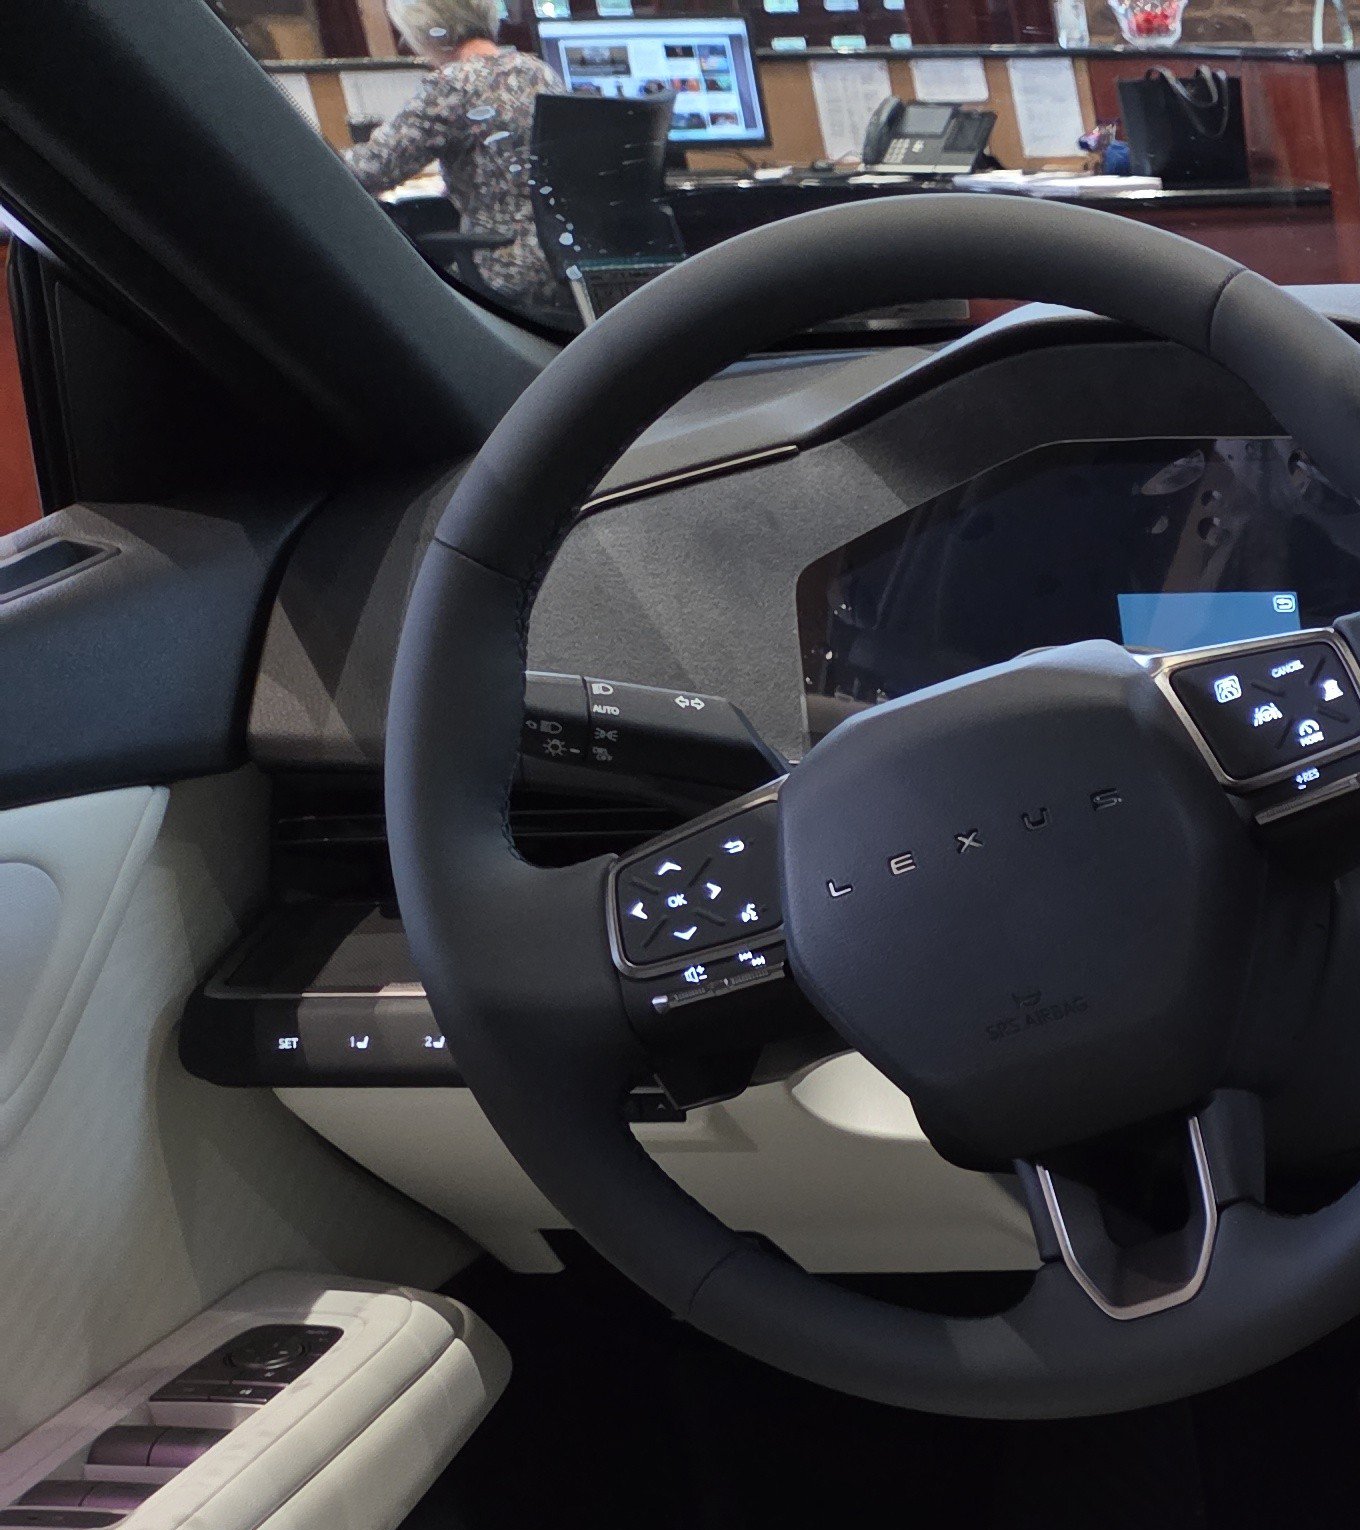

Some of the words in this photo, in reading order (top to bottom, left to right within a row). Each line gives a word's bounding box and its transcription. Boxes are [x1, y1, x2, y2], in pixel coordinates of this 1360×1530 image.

[1271, 660, 1305, 678] CANCEL
[593, 704, 620, 715] AUTO
[826, 787, 1123, 898] LEXUS
[667, 894, 688, 908] OK
[278, 1037, 299, 1049] SET
[349, 1036, 355, 1047] 1
[424, 1036, 433, 1047] 2
